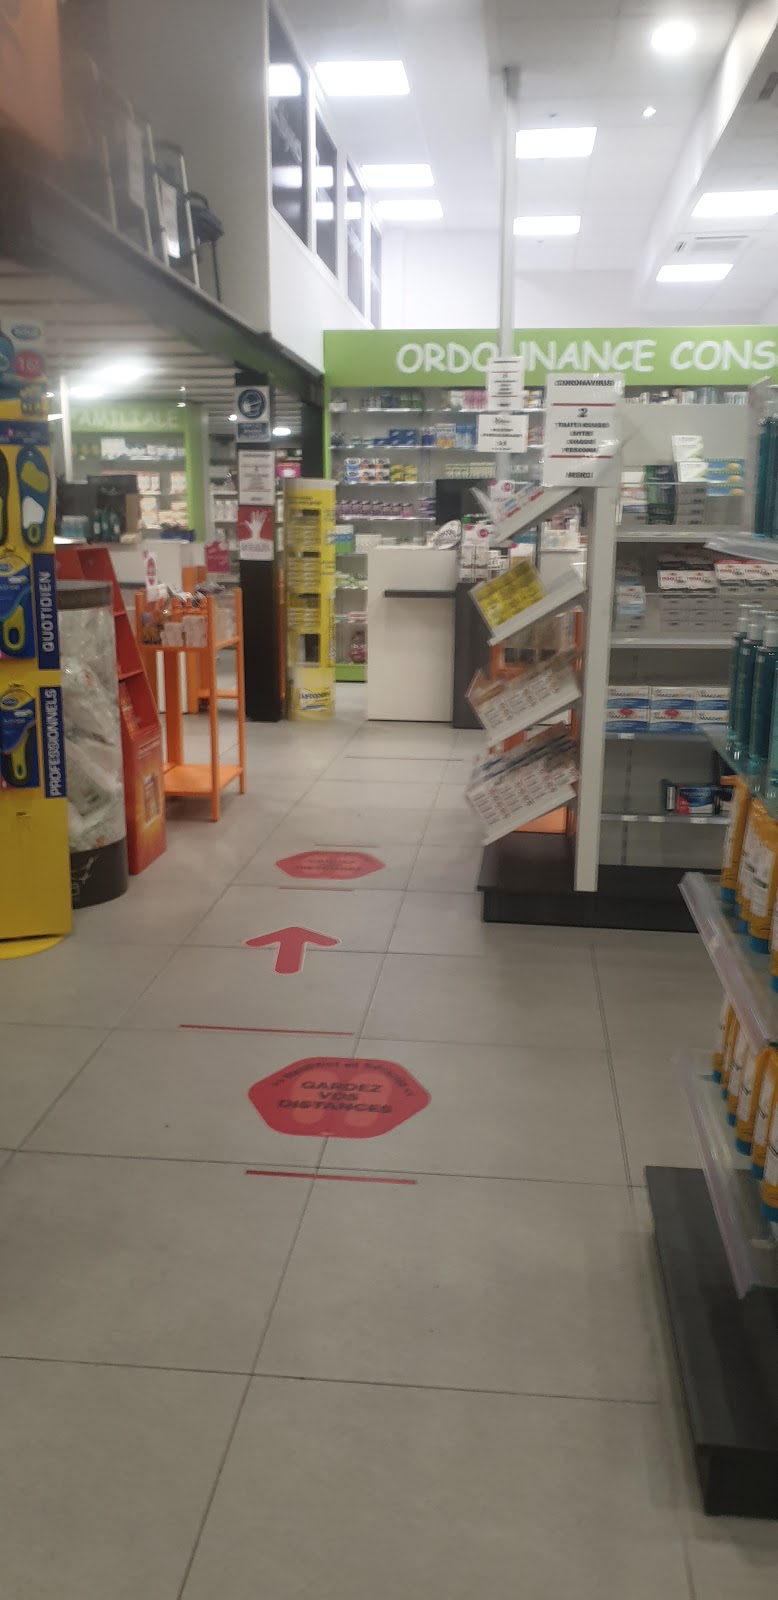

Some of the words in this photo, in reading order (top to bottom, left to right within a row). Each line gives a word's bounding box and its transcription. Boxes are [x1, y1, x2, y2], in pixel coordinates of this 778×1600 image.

[670, 340, 778, 371] CONS
[40, 571, 54, 653] QUOTIDIEN
[44, 687, 64, 796] PROFESSIONNELS
[300, 1081, 383, 1093] GARDEZ
[319, 1091, 359, 1101] VOS
[277, 1100, 393, 1114] DISTANCES
